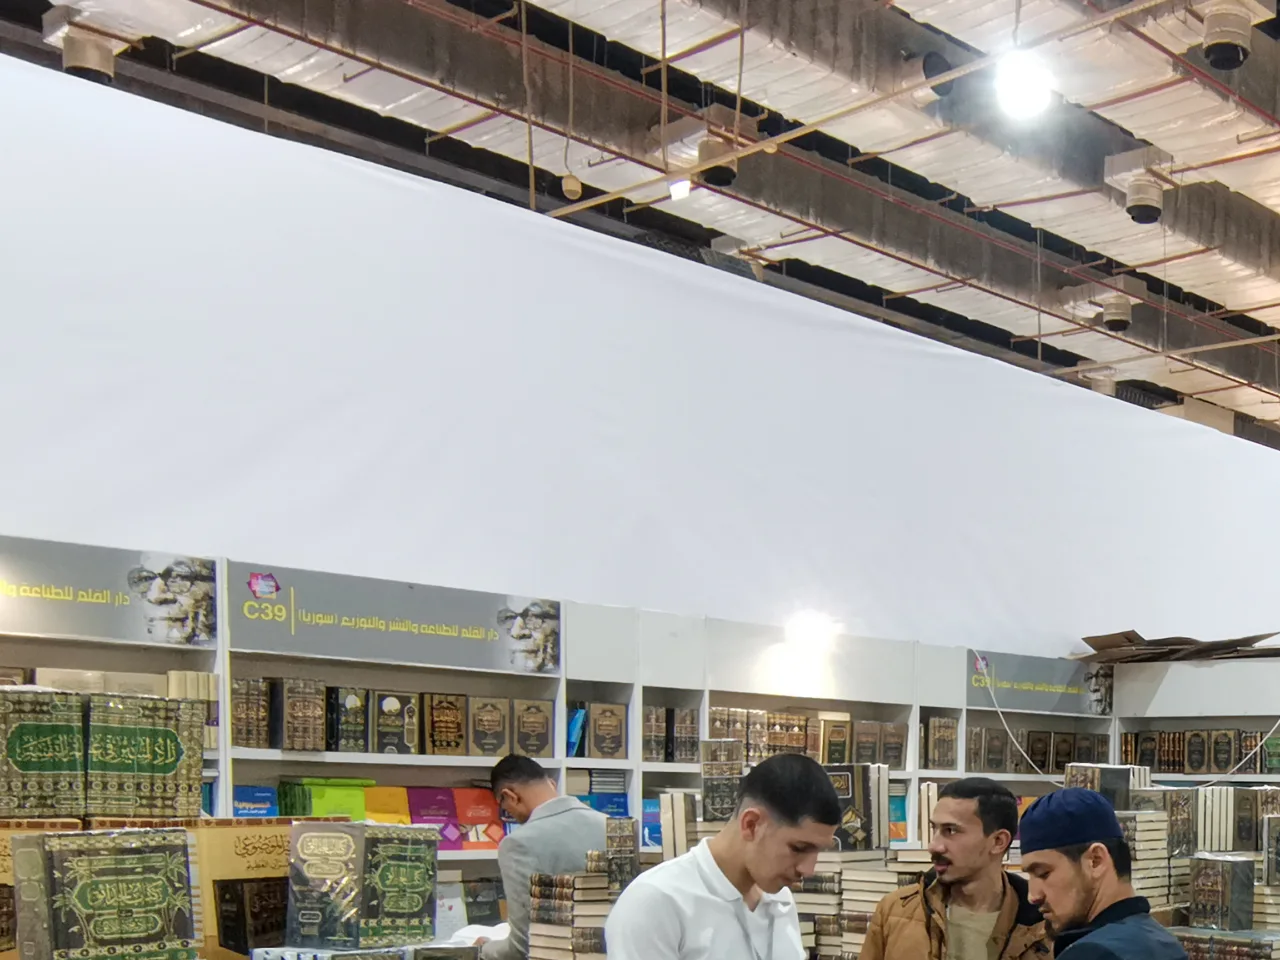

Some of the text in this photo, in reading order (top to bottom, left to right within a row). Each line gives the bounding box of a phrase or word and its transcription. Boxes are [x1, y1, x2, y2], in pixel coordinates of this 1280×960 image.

[77, 588, 111, 604] القلم
[114, 592, 131, 607] دار
[243, 601, 287, 622] C39
